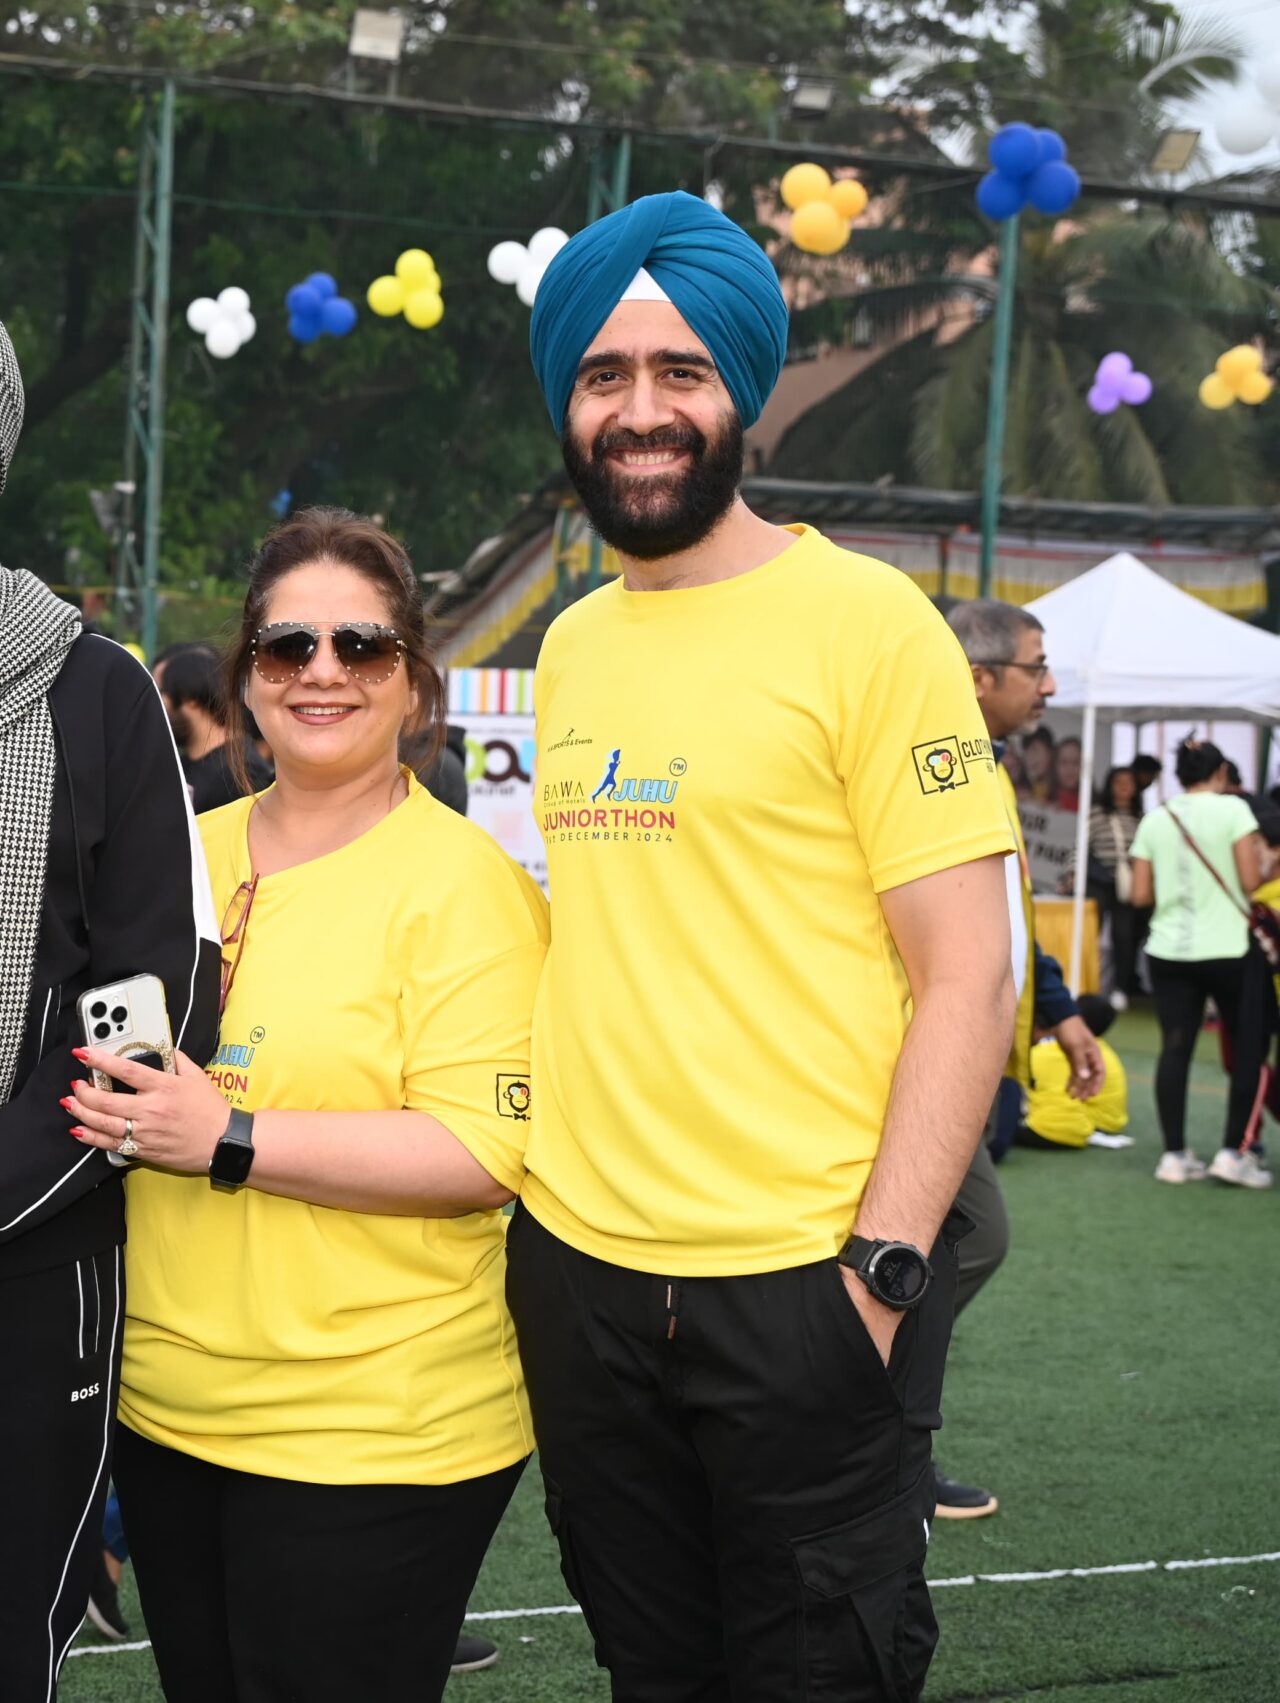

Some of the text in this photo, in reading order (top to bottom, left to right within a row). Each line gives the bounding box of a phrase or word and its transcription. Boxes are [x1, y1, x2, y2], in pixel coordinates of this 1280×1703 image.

[543, 780, 585, 801] BAWA
[612, 778, 678, 803] JUHU
[543, 809, 676, 832] JUNIORTHON
[560, 831, 629, 842] DECEMBER
[636, 832, 673, 843] 2024
[71, 1382, 99, 1402] BOSS
